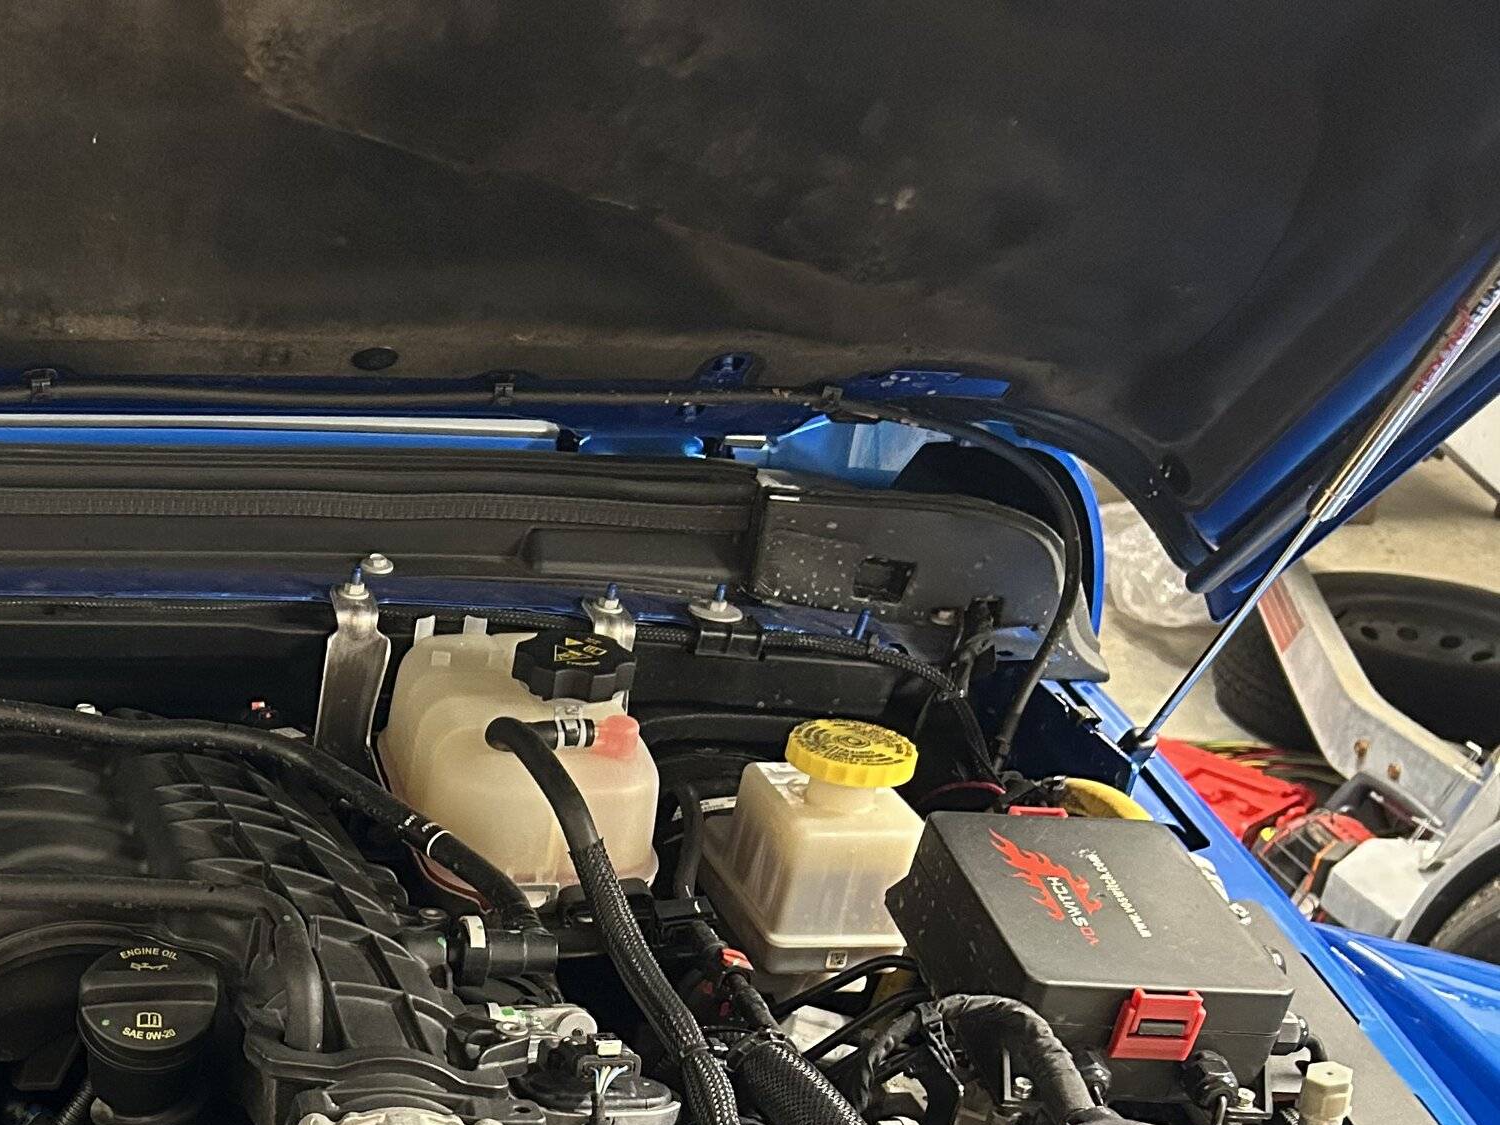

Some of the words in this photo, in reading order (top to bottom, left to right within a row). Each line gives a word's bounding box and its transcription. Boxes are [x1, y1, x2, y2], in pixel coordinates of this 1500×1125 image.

[120, 947, 160, 959] ENGINE
[162, 949, 178, 960] OIL
[122, 1026, 144, 1039] SAE
[146, 1028, 176, 1040] 0W-20
